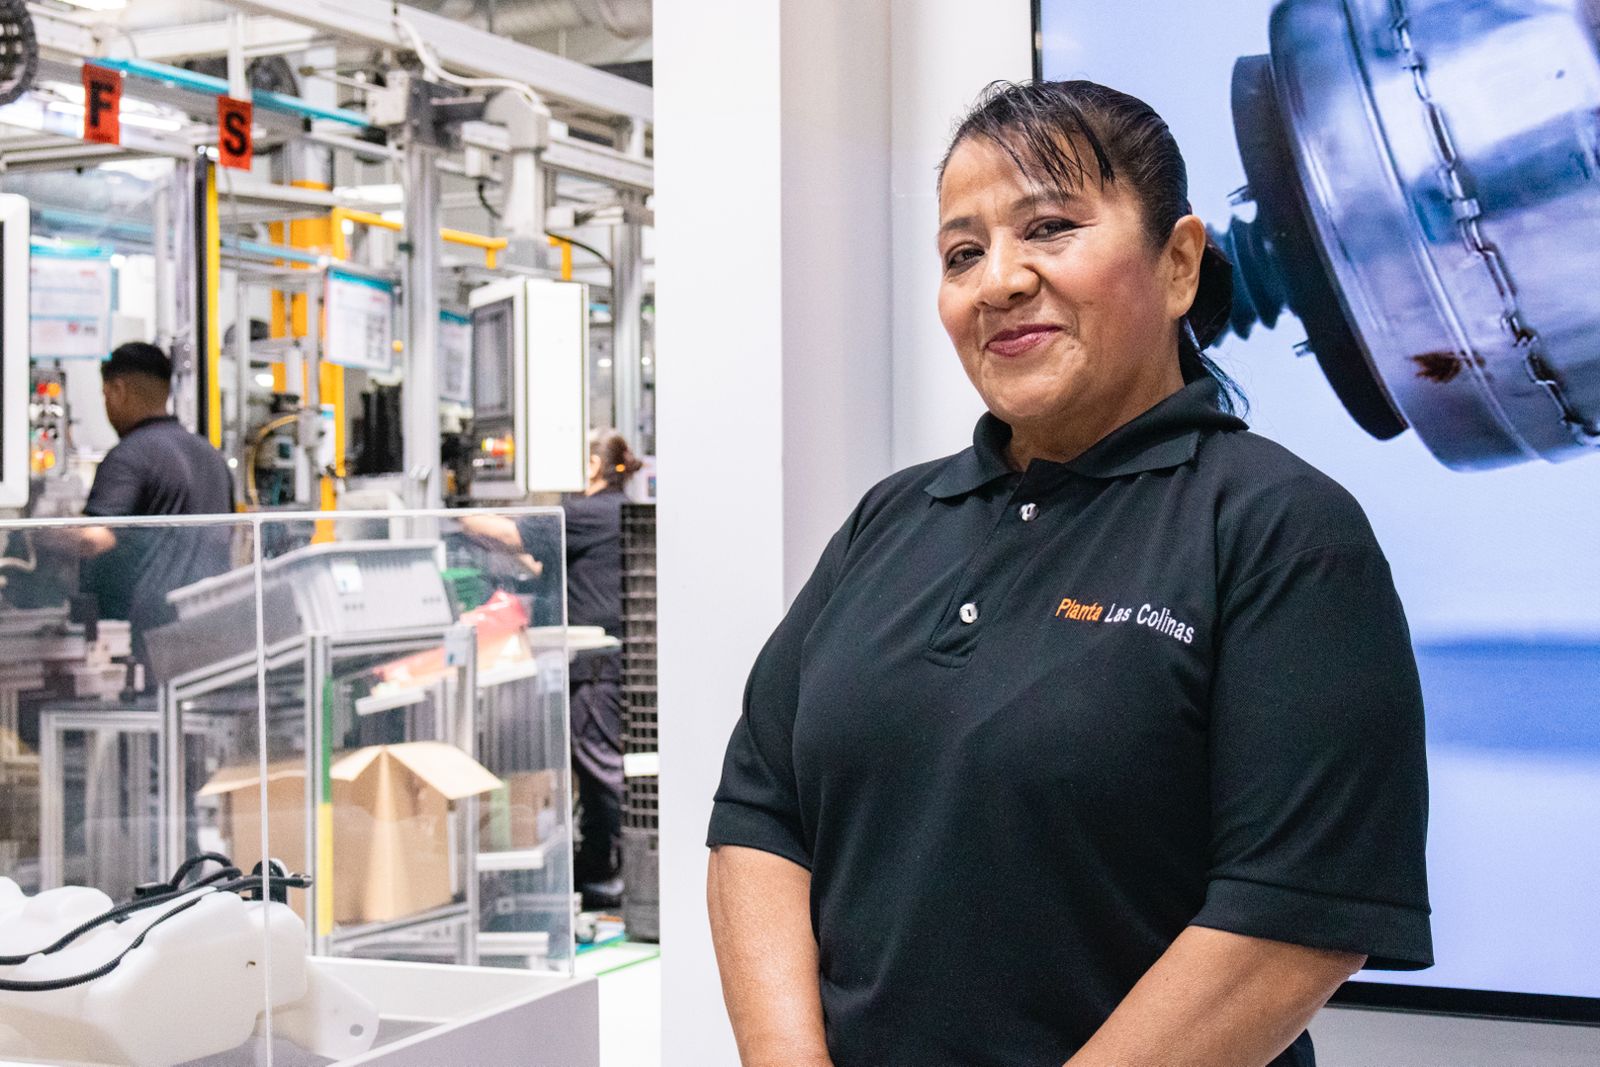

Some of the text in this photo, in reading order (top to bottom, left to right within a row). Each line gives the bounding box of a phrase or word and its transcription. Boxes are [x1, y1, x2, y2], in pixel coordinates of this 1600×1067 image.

[90, 80, 114, 127] F
[223, 111, 247, 156] S
[1055, 598, 1195, 644] Planta Las Colinas
